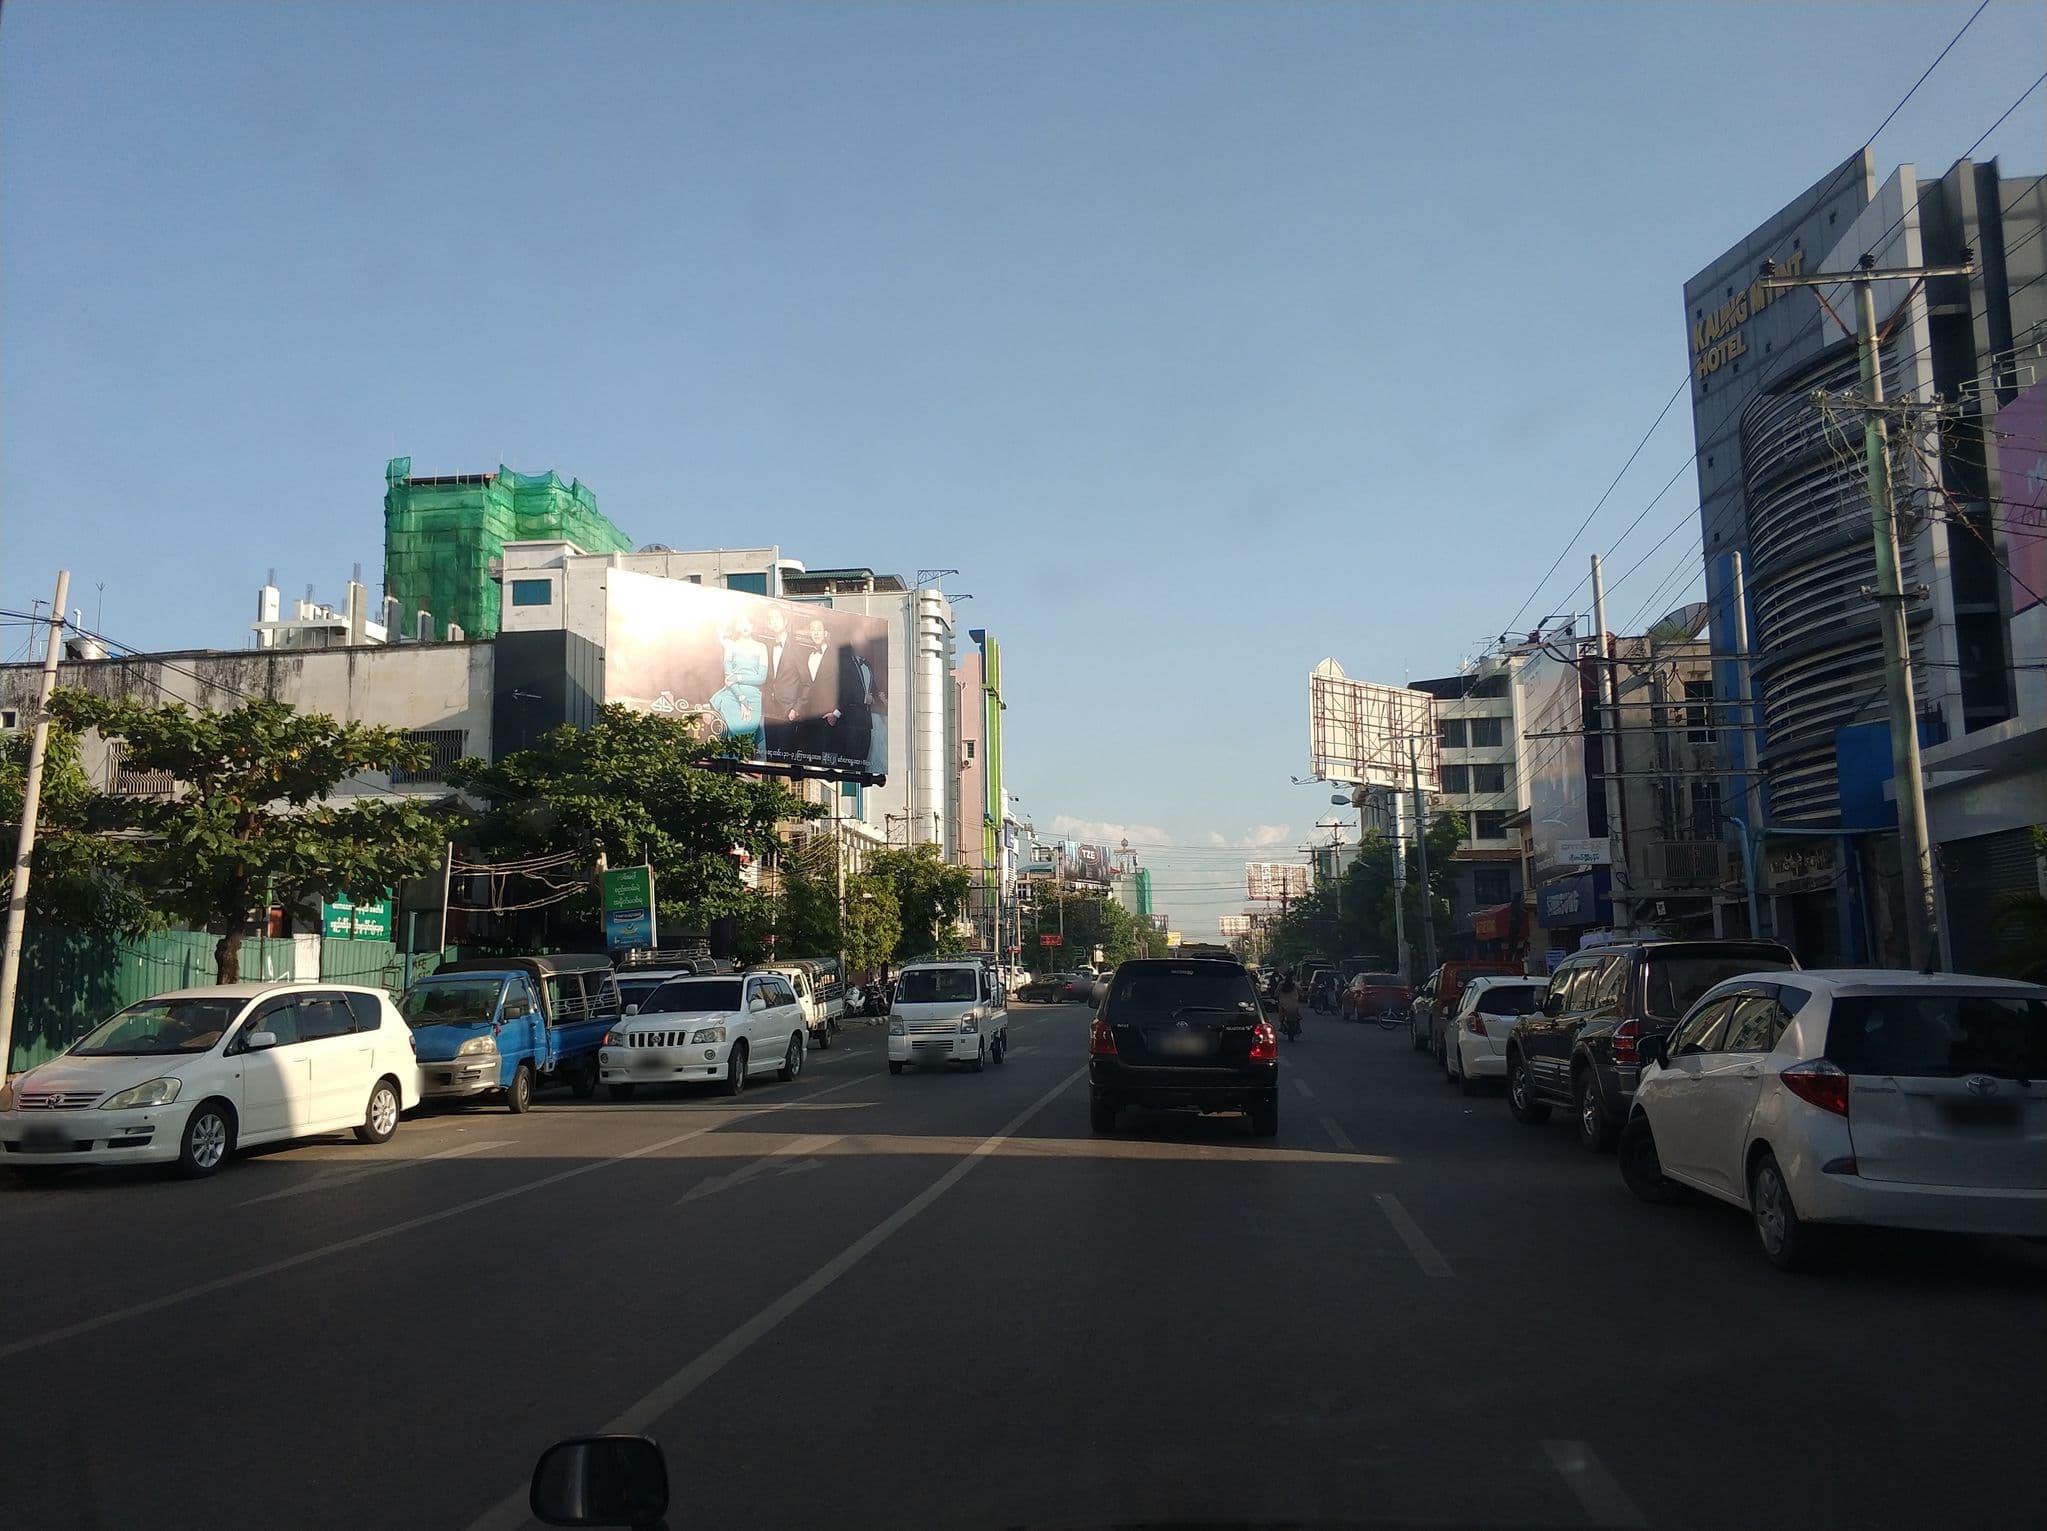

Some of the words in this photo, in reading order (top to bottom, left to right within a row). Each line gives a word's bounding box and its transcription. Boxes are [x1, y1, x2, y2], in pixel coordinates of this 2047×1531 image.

[1694, 289, 1748, 353] KAUNG
[1695, 331, 1747, 379] HOTEL
[1082, 849, 1095, 859] TZE
